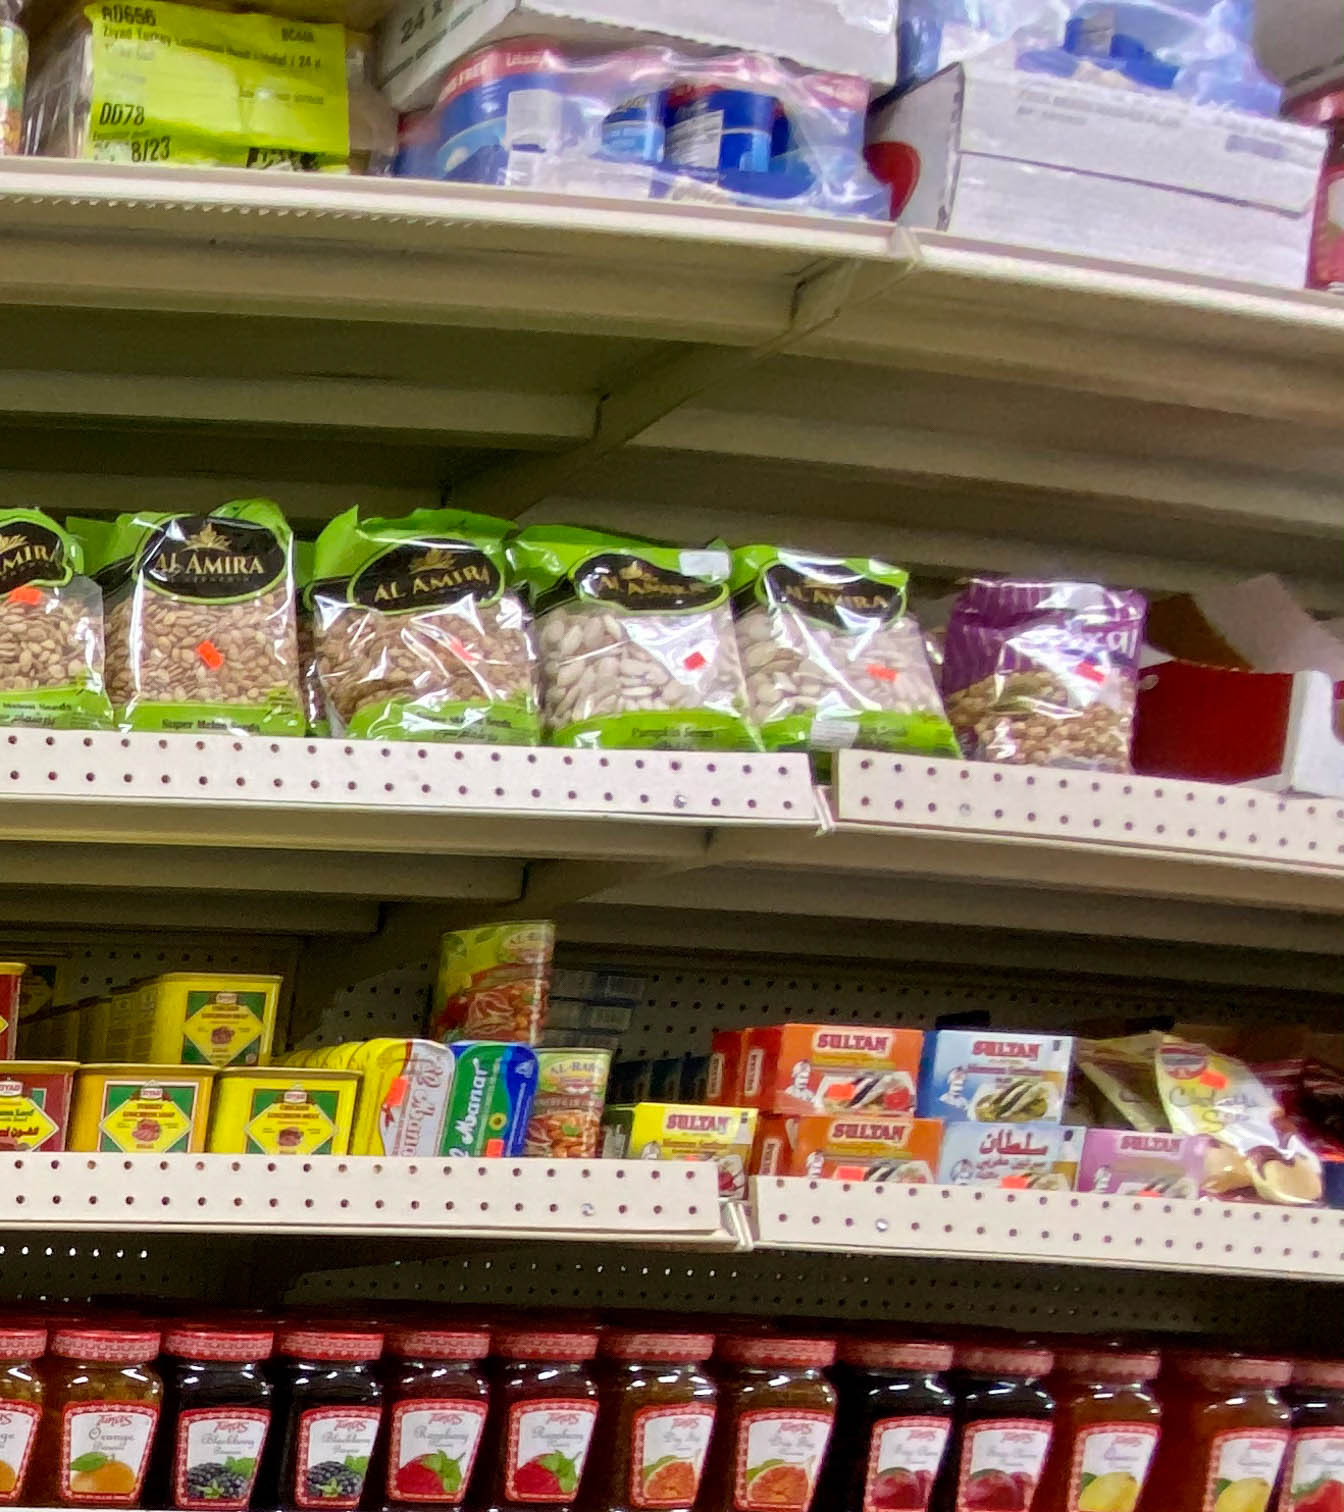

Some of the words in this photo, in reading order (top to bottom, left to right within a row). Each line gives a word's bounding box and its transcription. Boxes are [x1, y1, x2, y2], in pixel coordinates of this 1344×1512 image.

[185, 554, 266, 576] AMIRA
[374, 583, 407, 602] AL
[411, 565, 492, 596] AMIRA
[817, 1033, 889, 1052] SULTAN
[970, 1041, 1041, 1060] SULTAN
[666, 1114, 729, 1133] SULTAN
[833, 1123, 907, 1143] SULTAN
